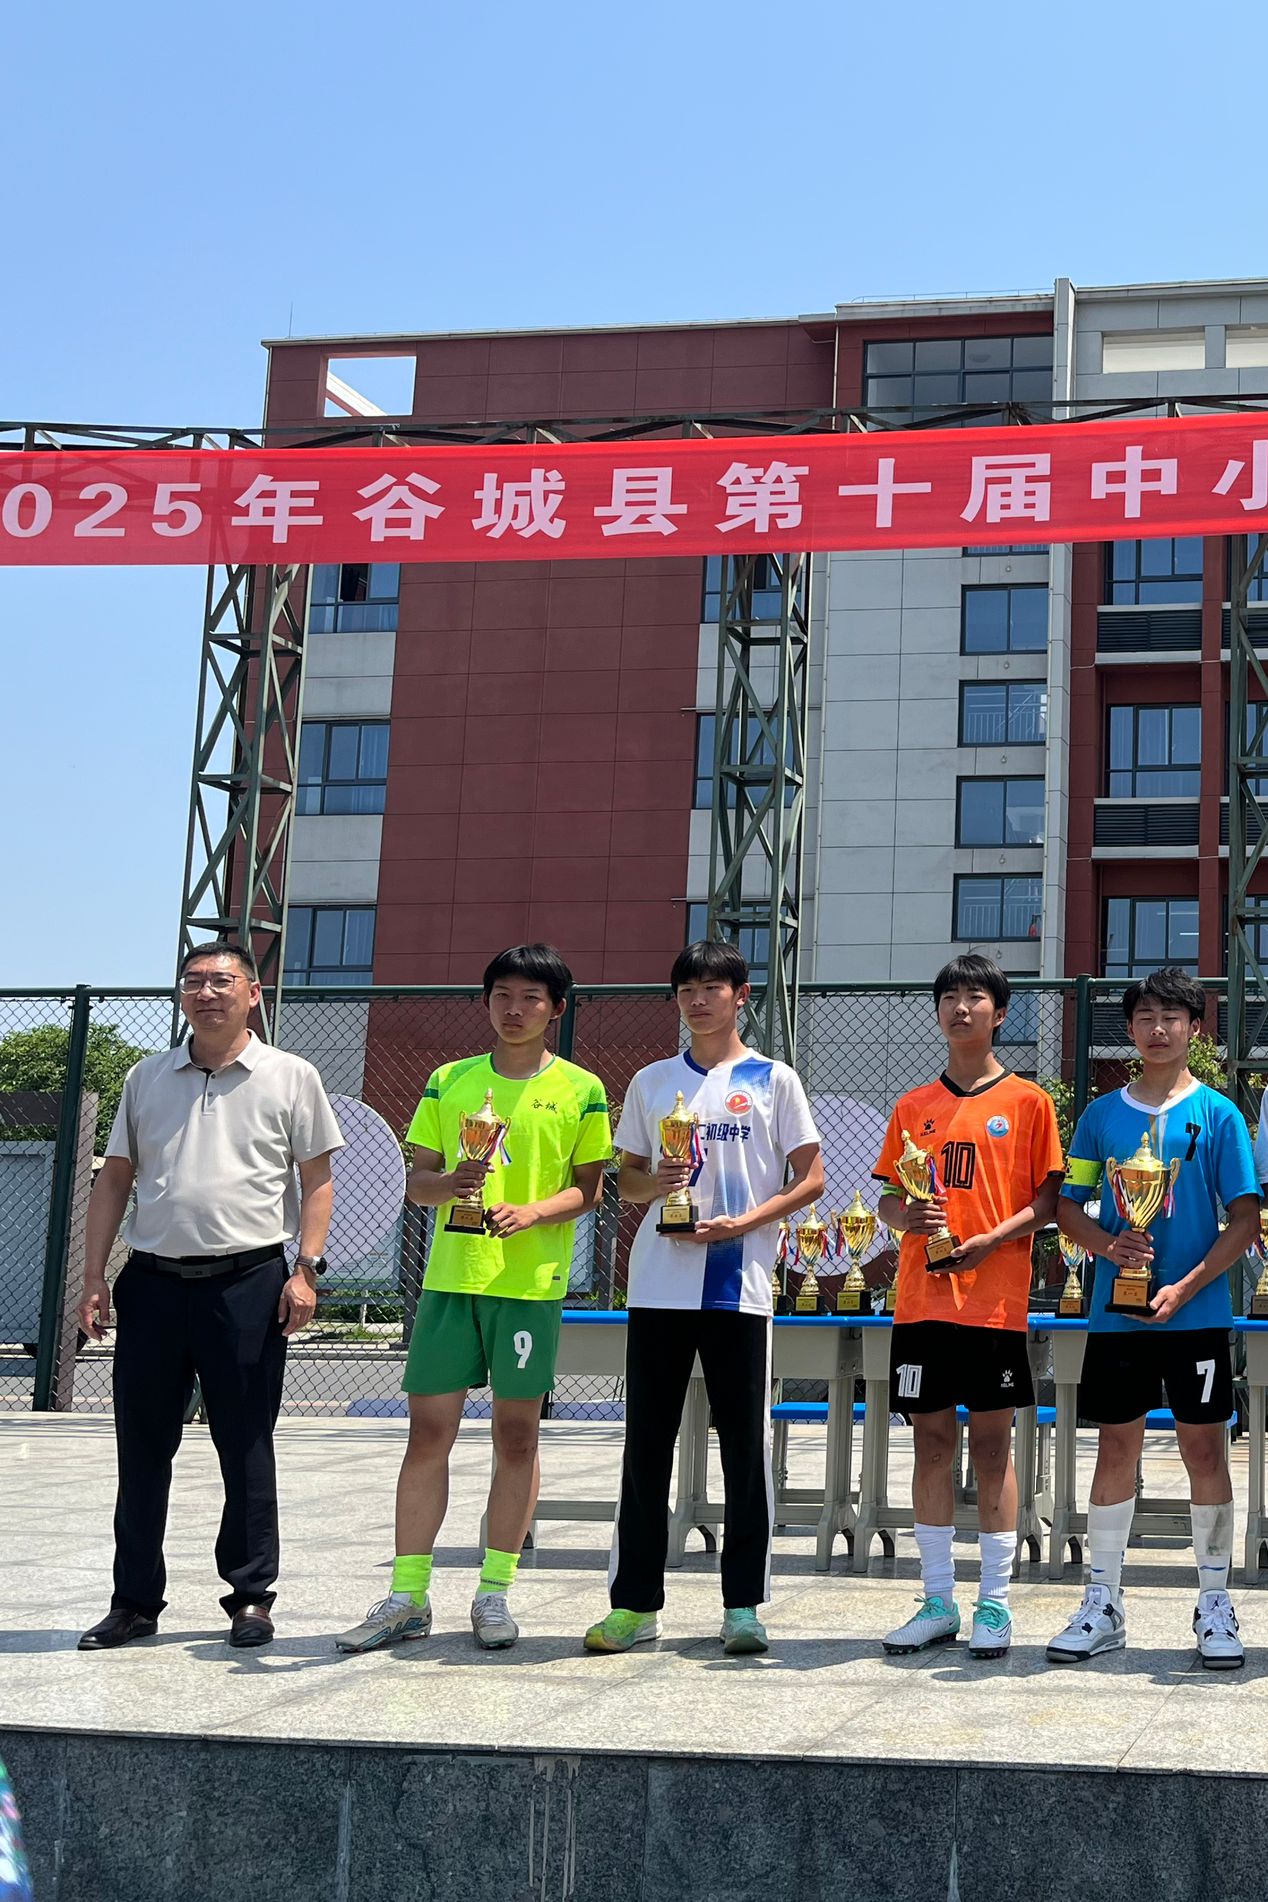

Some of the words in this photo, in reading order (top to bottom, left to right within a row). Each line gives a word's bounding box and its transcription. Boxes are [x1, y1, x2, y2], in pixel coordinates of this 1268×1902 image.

[1185, 1122, 1201, 1162] 7
[941, 1140, 976, 1190] 10
[513, 1330, 533, 1369] 9
[896, 1363, 923, 1398] 10
[1196, 1358, 1216, 1403] 7
